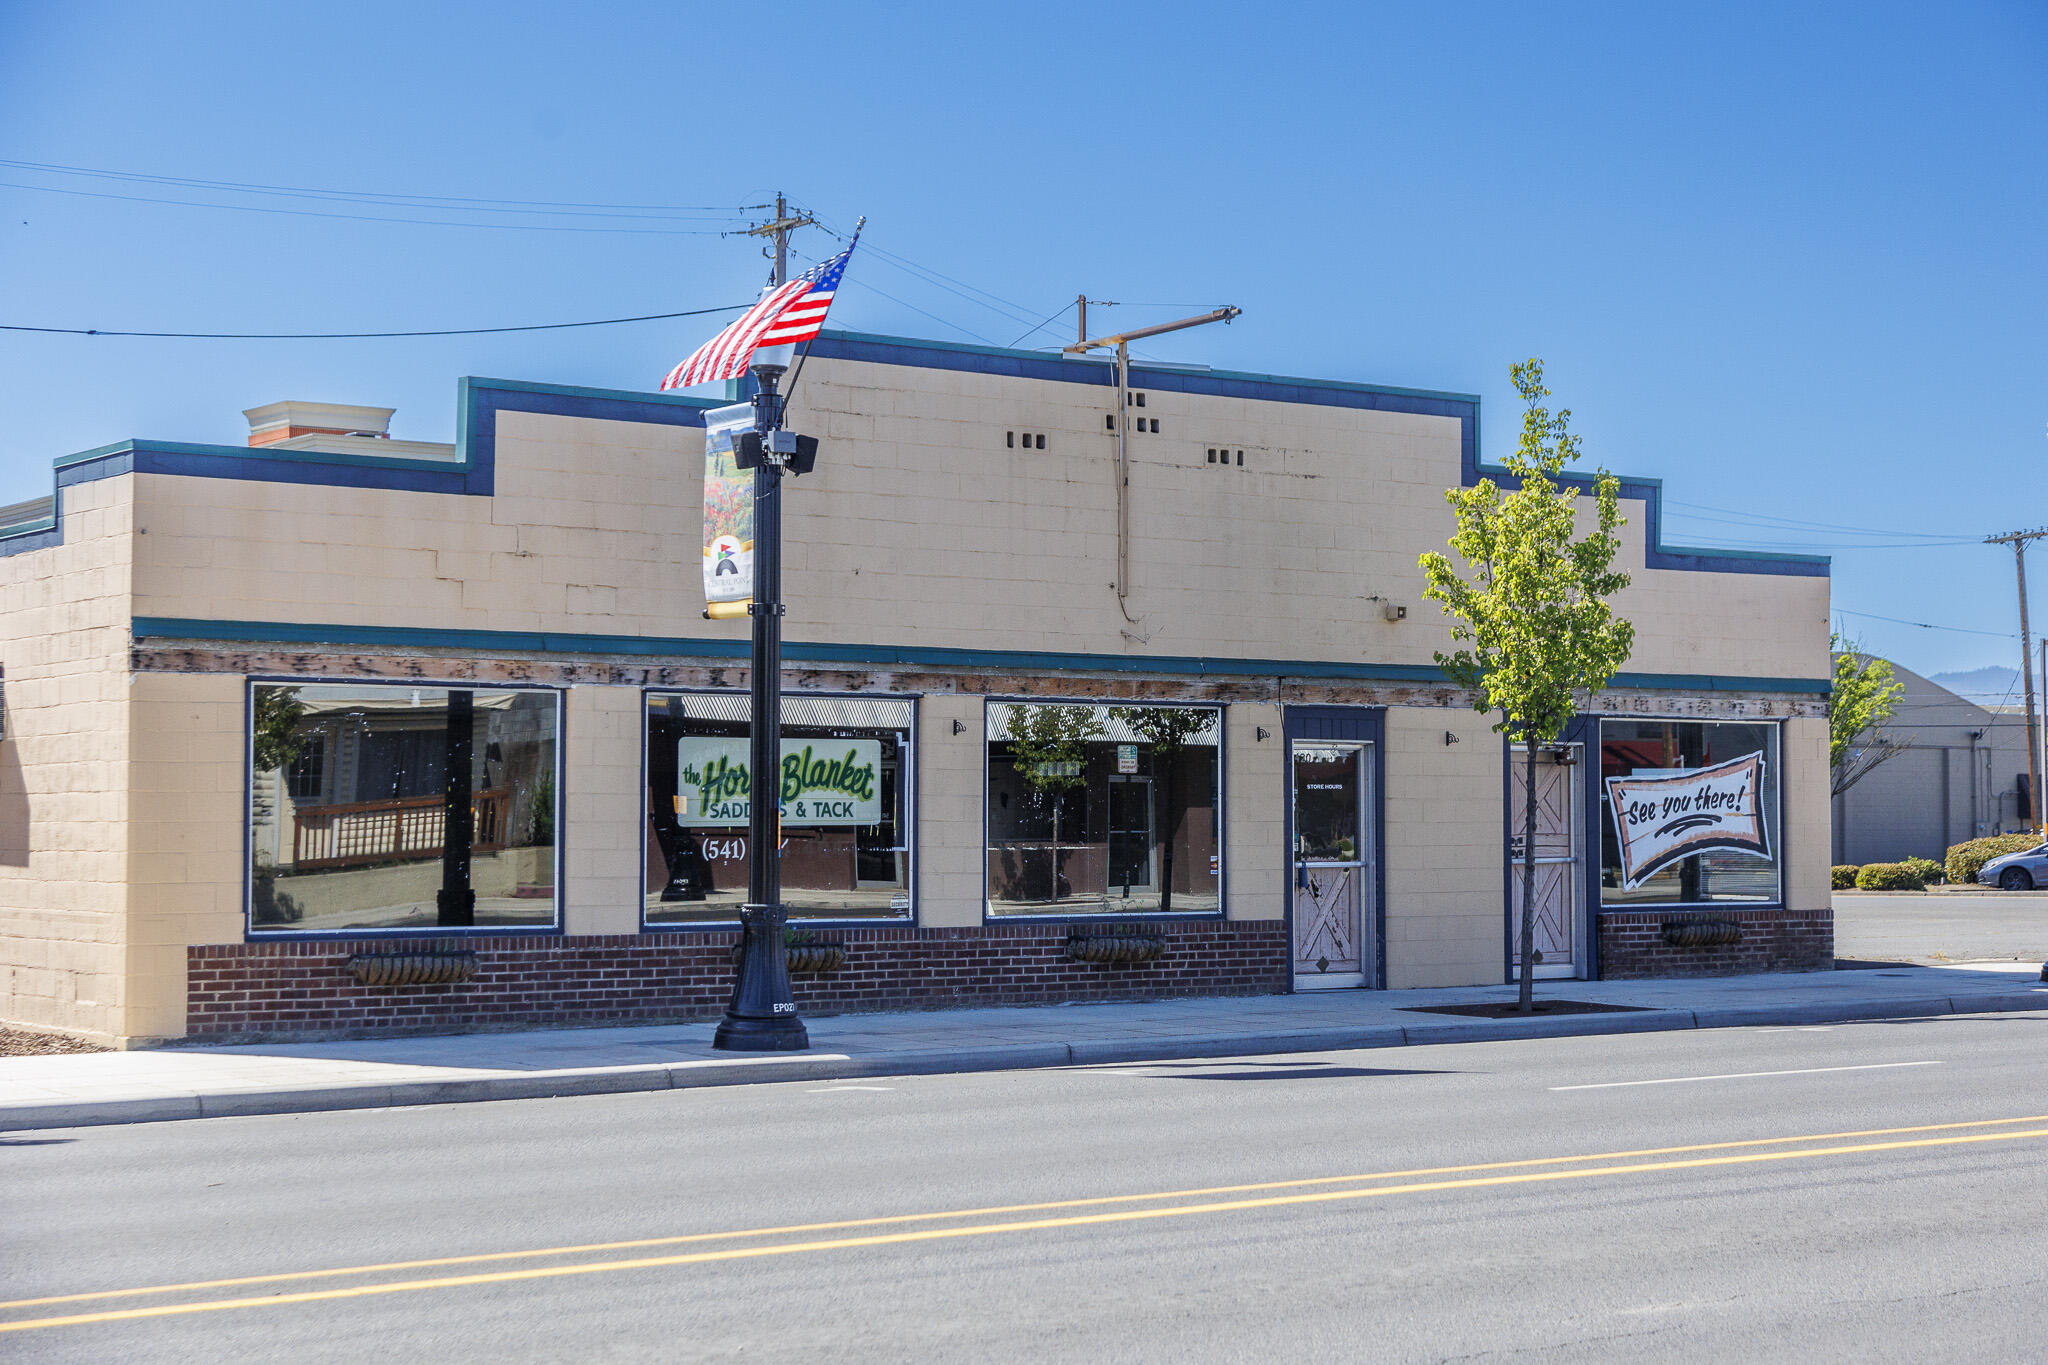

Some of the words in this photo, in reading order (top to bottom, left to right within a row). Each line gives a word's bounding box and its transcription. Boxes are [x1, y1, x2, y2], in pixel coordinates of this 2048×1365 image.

[682, 763, 701, 786] the
[700, 755, 750, 815] Hor
[781, 746, 874, 804] Blanket
[710, 802, 787, 818] SADS
[795, 802, 806, 817] &
[813, 802, 854, 818] TACK
[1662, 796, 1691, 820] you
[702, 837, 746, 861] (541)
